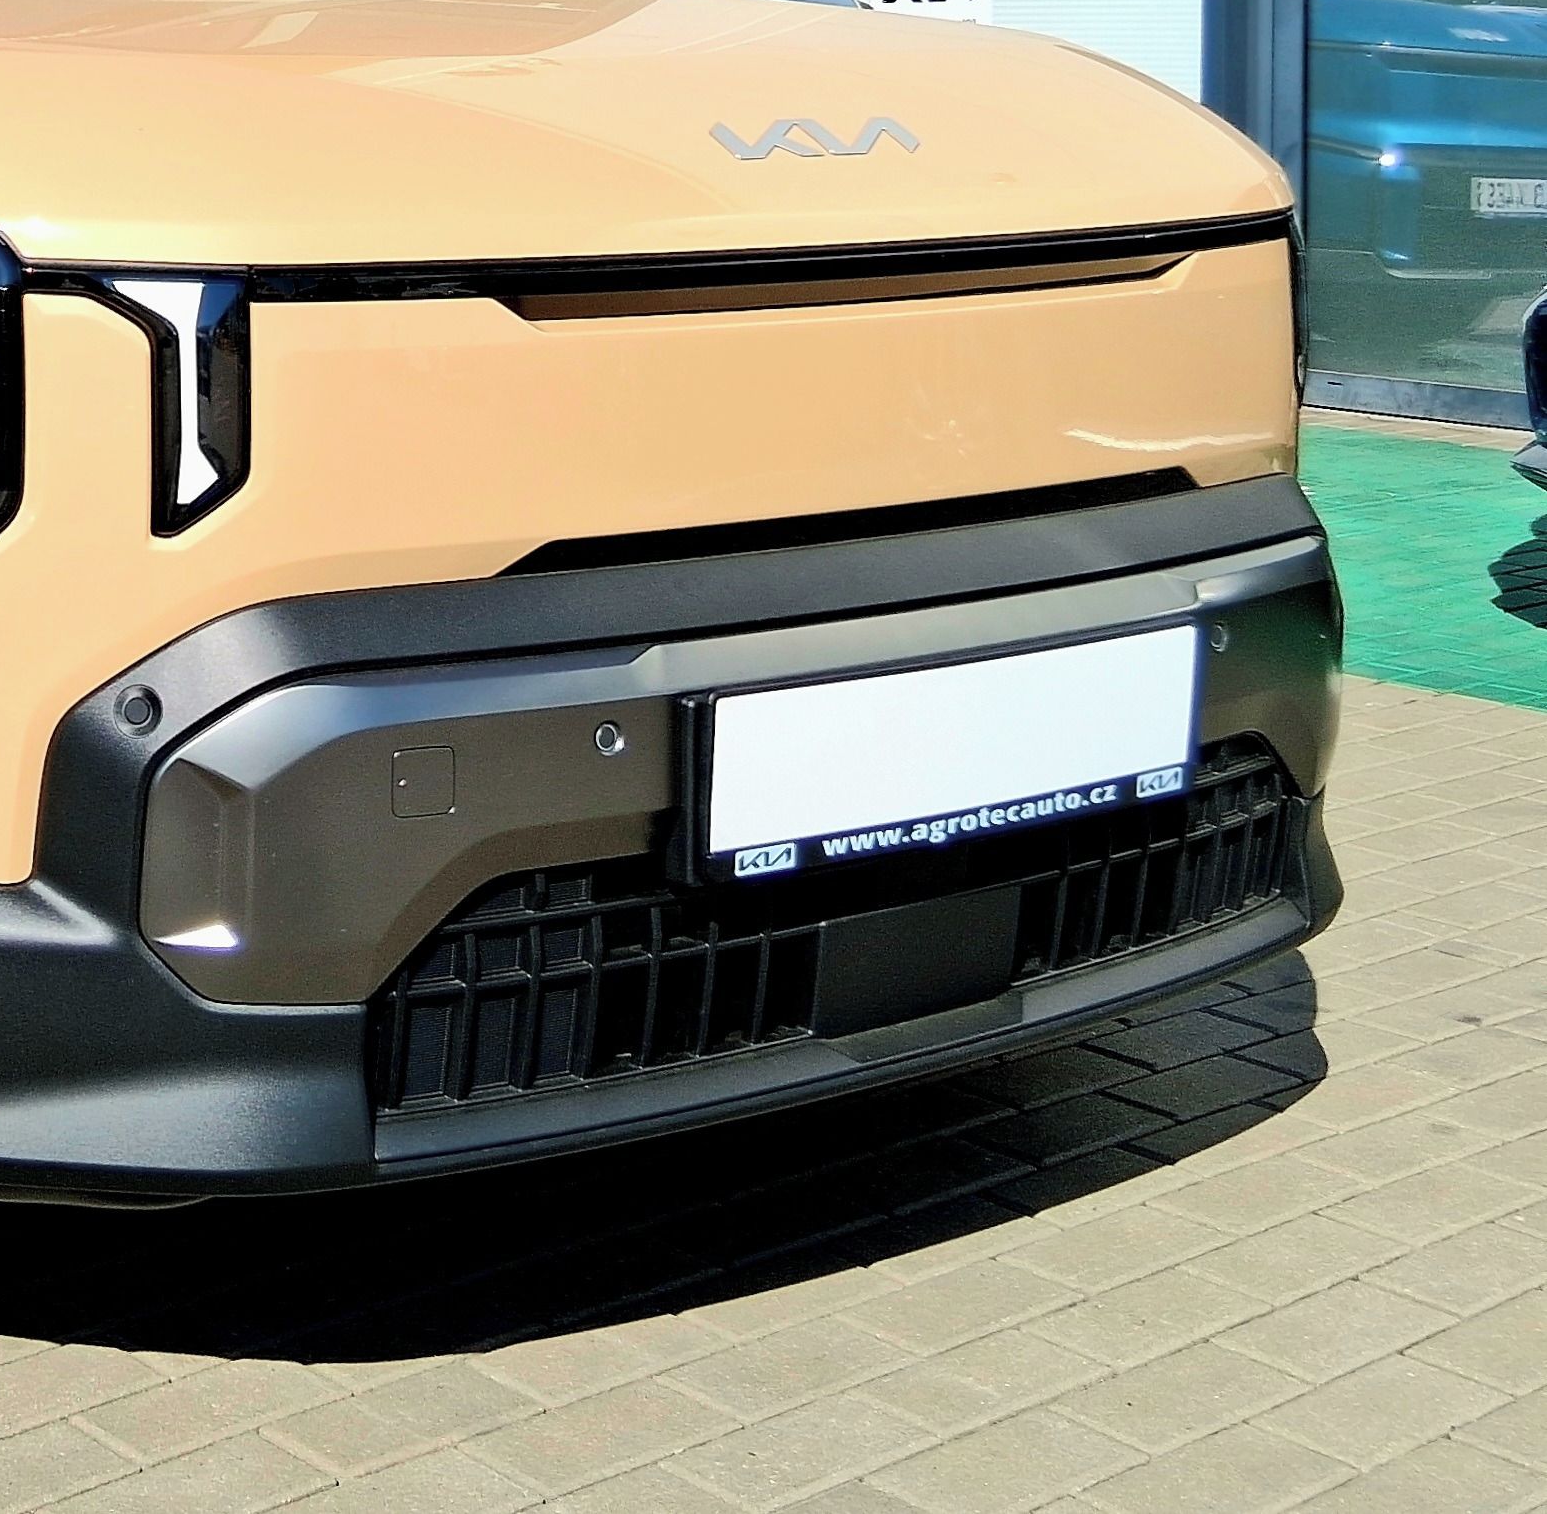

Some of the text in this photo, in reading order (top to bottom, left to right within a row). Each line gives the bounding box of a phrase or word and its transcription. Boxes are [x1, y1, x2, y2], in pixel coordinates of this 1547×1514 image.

[709, 117, 920, 160] KIA
[738, 772, 1179, 871] KIA www.agrotecauto.cz KIA
